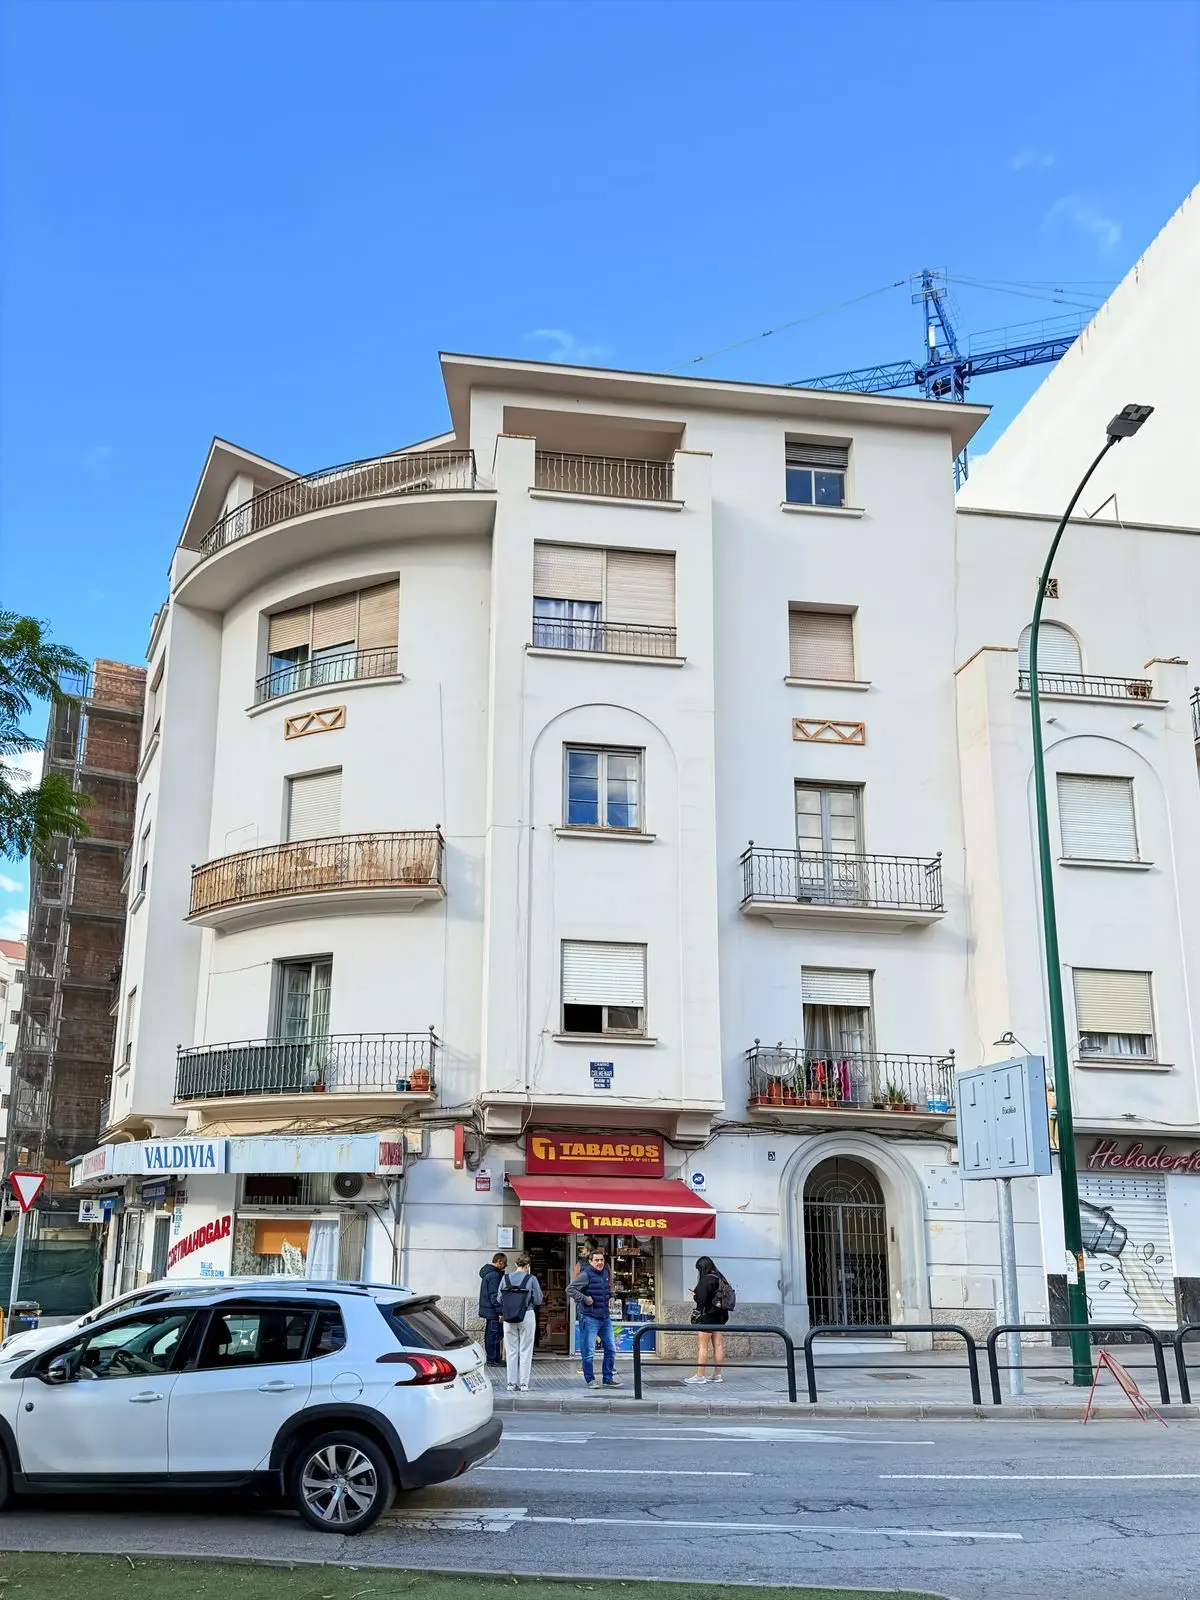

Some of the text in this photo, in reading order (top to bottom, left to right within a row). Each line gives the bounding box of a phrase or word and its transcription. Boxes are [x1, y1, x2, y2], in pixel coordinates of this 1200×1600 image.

[144, 1144, 216, 1169] VALDIVIA
[560, 1143, 659, 1157] TABACOS
[591, 1216, 667, 1229] TABACOS
